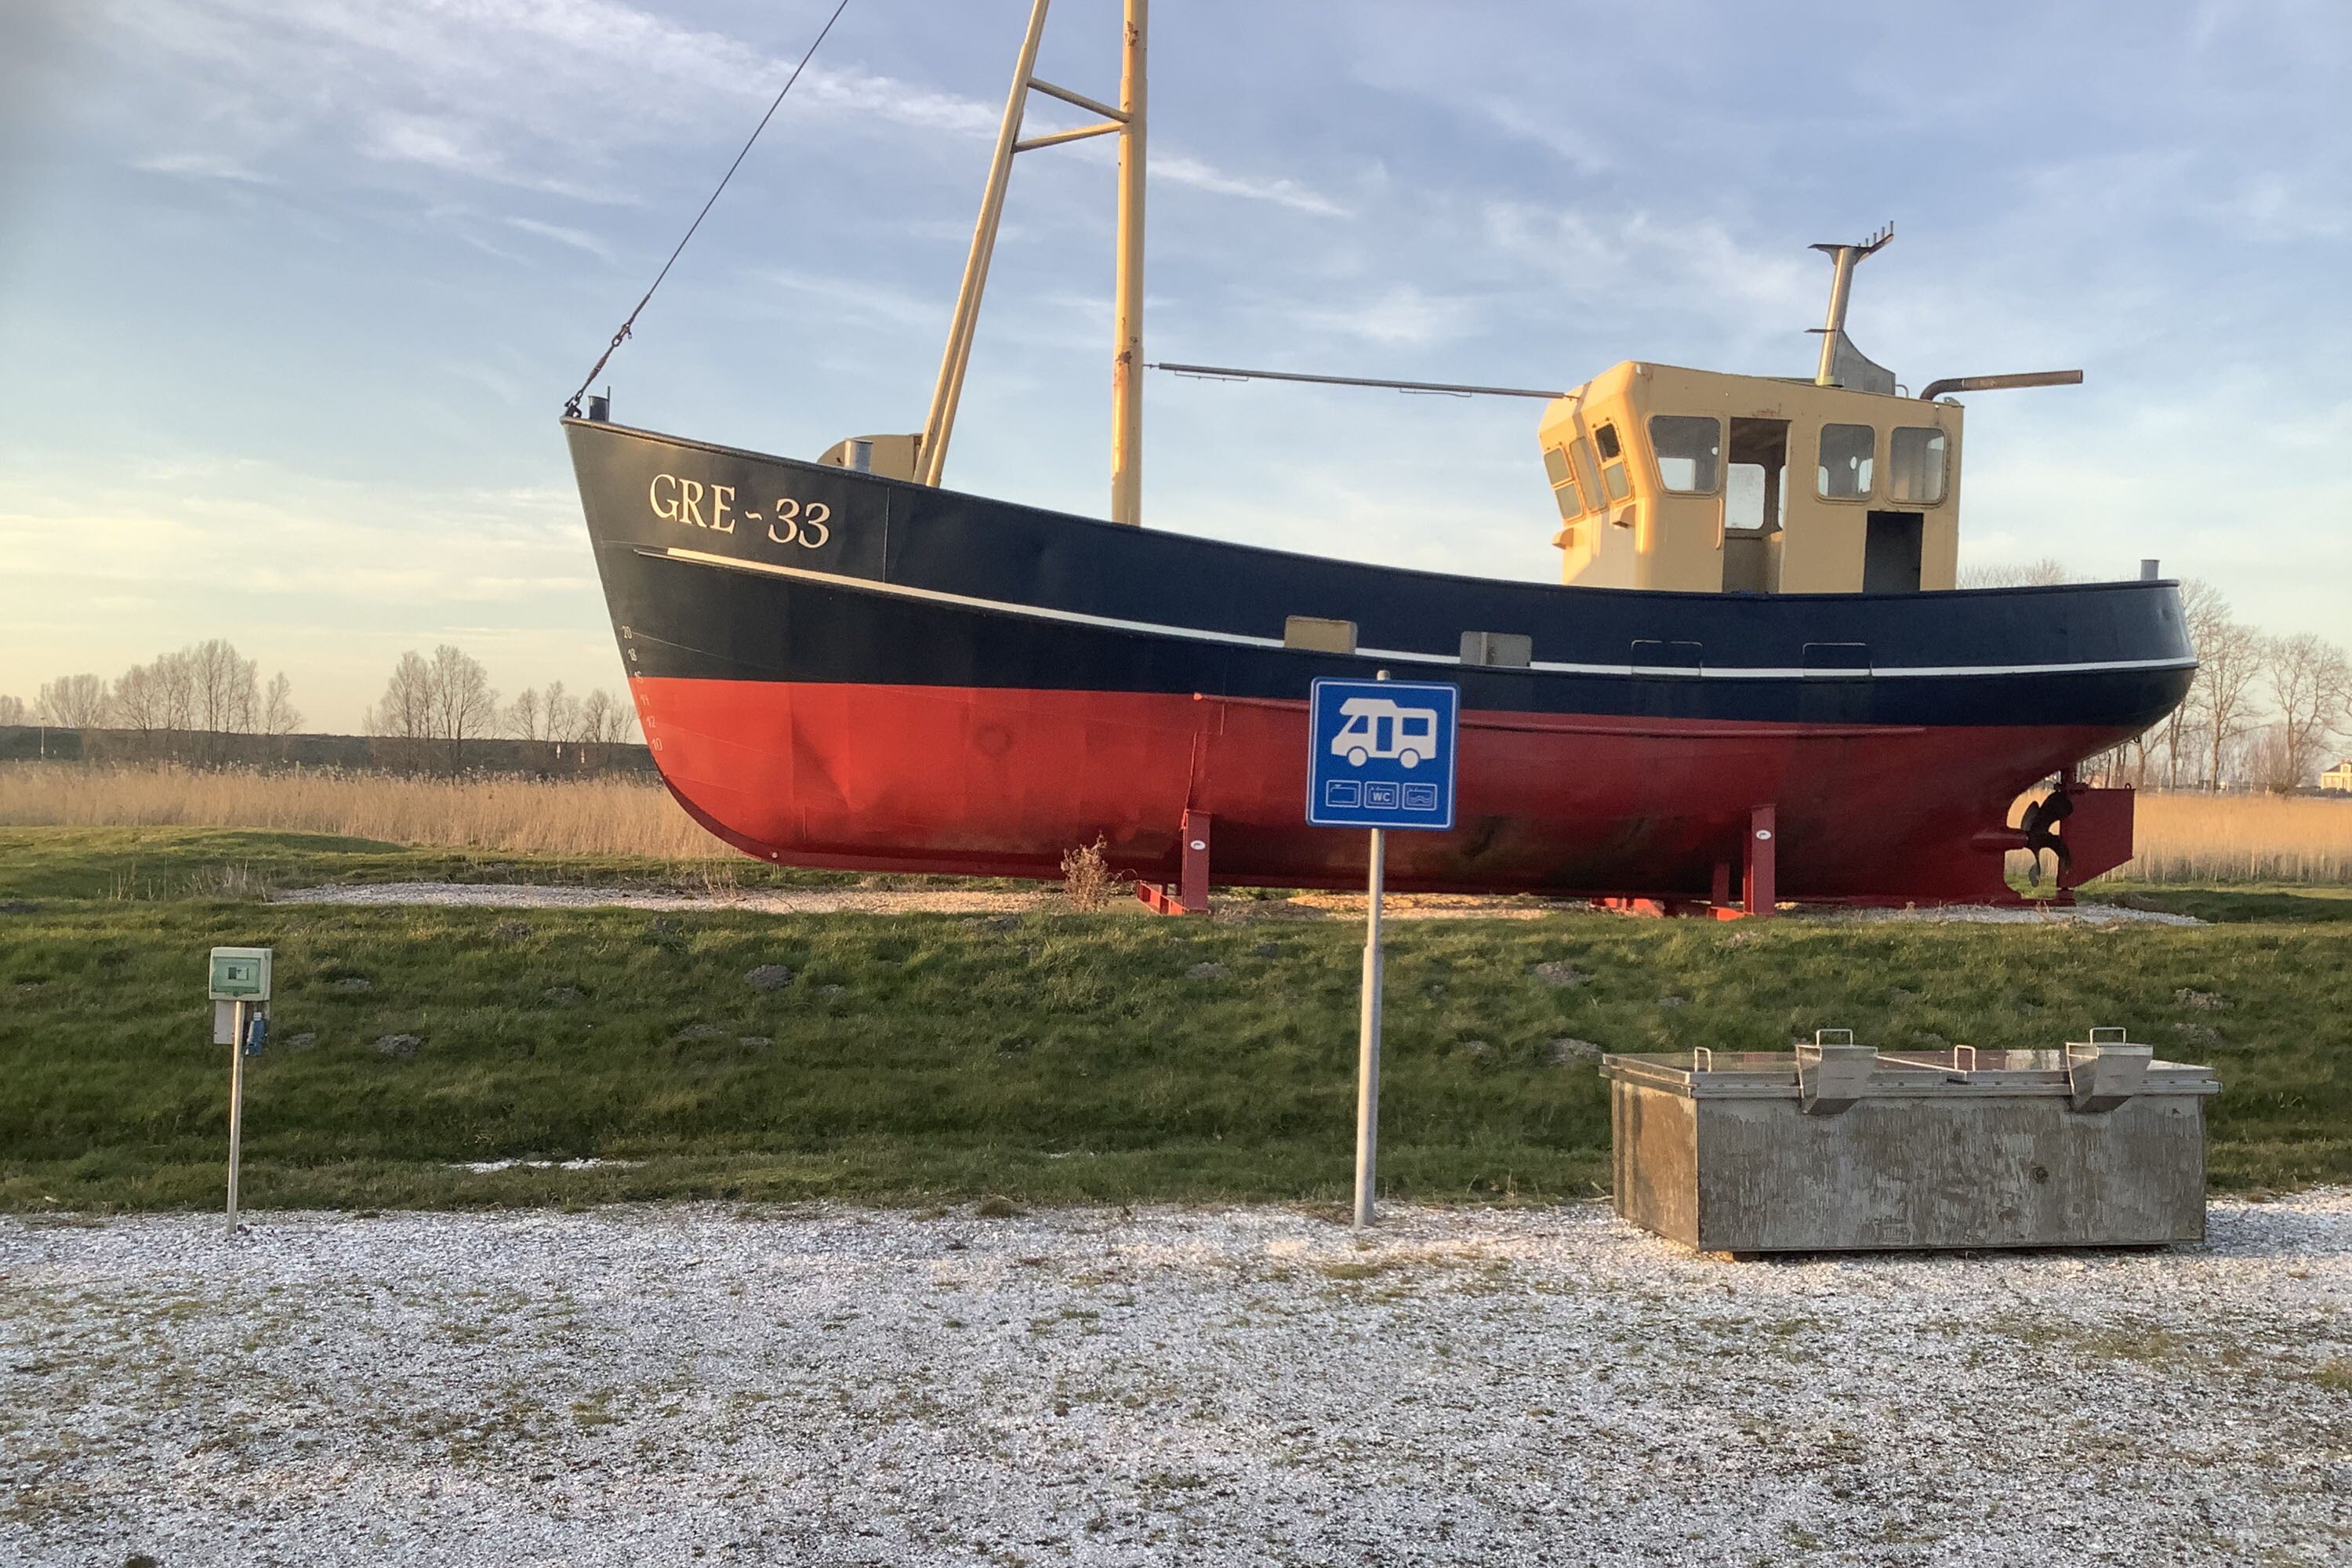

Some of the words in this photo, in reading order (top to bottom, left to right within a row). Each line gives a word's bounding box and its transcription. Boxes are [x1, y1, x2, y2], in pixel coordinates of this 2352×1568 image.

[646, 714, 657, 728] 12
[651, 737, 663, 752] 10
[1373, 792, 1392, 803] WC
